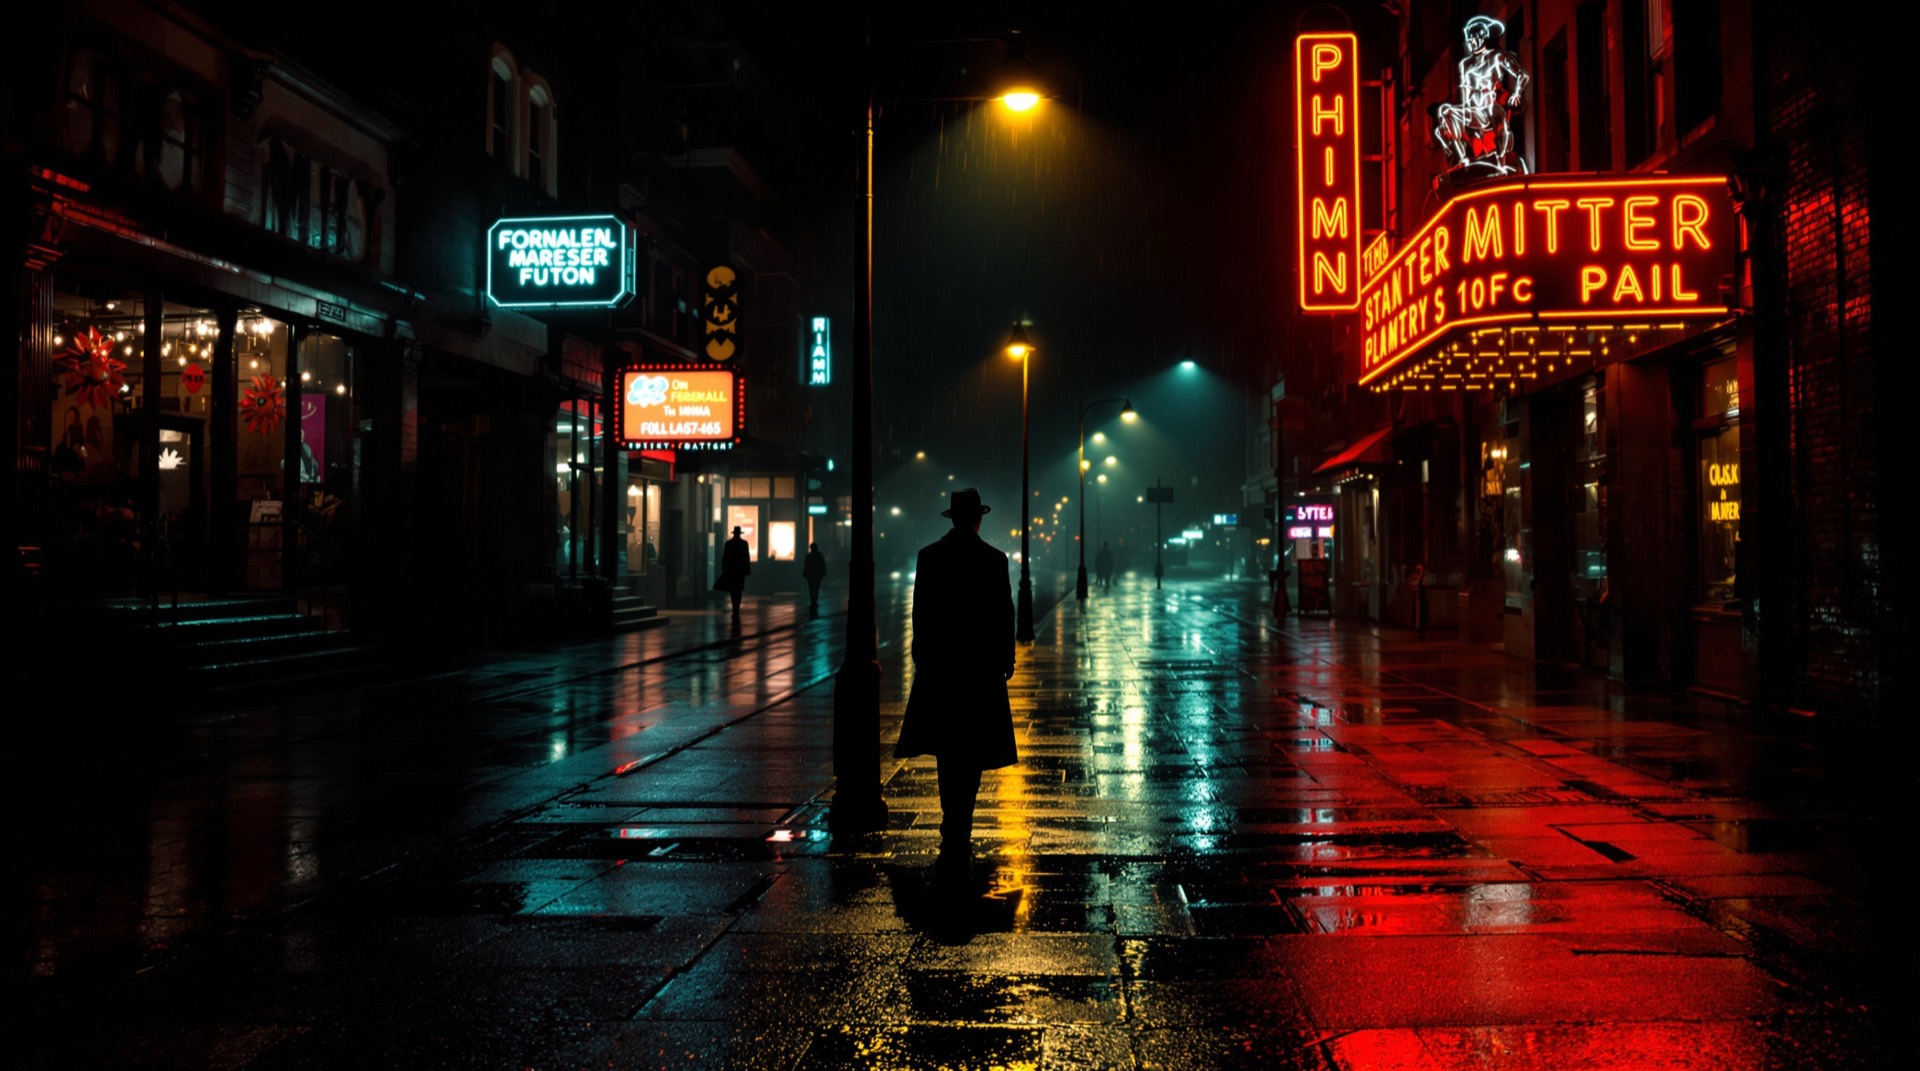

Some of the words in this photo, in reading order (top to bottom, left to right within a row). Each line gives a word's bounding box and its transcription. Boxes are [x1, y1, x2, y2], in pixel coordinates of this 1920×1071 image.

[1311, 43, 1348, 294] PHIMN
[1463, 194, 1711, 264] MITTER
[509, 248, 609, 268] MARESER
[519, 267, 595, 286] FUTON
[1582, 264, 1698, 302] PAIL
